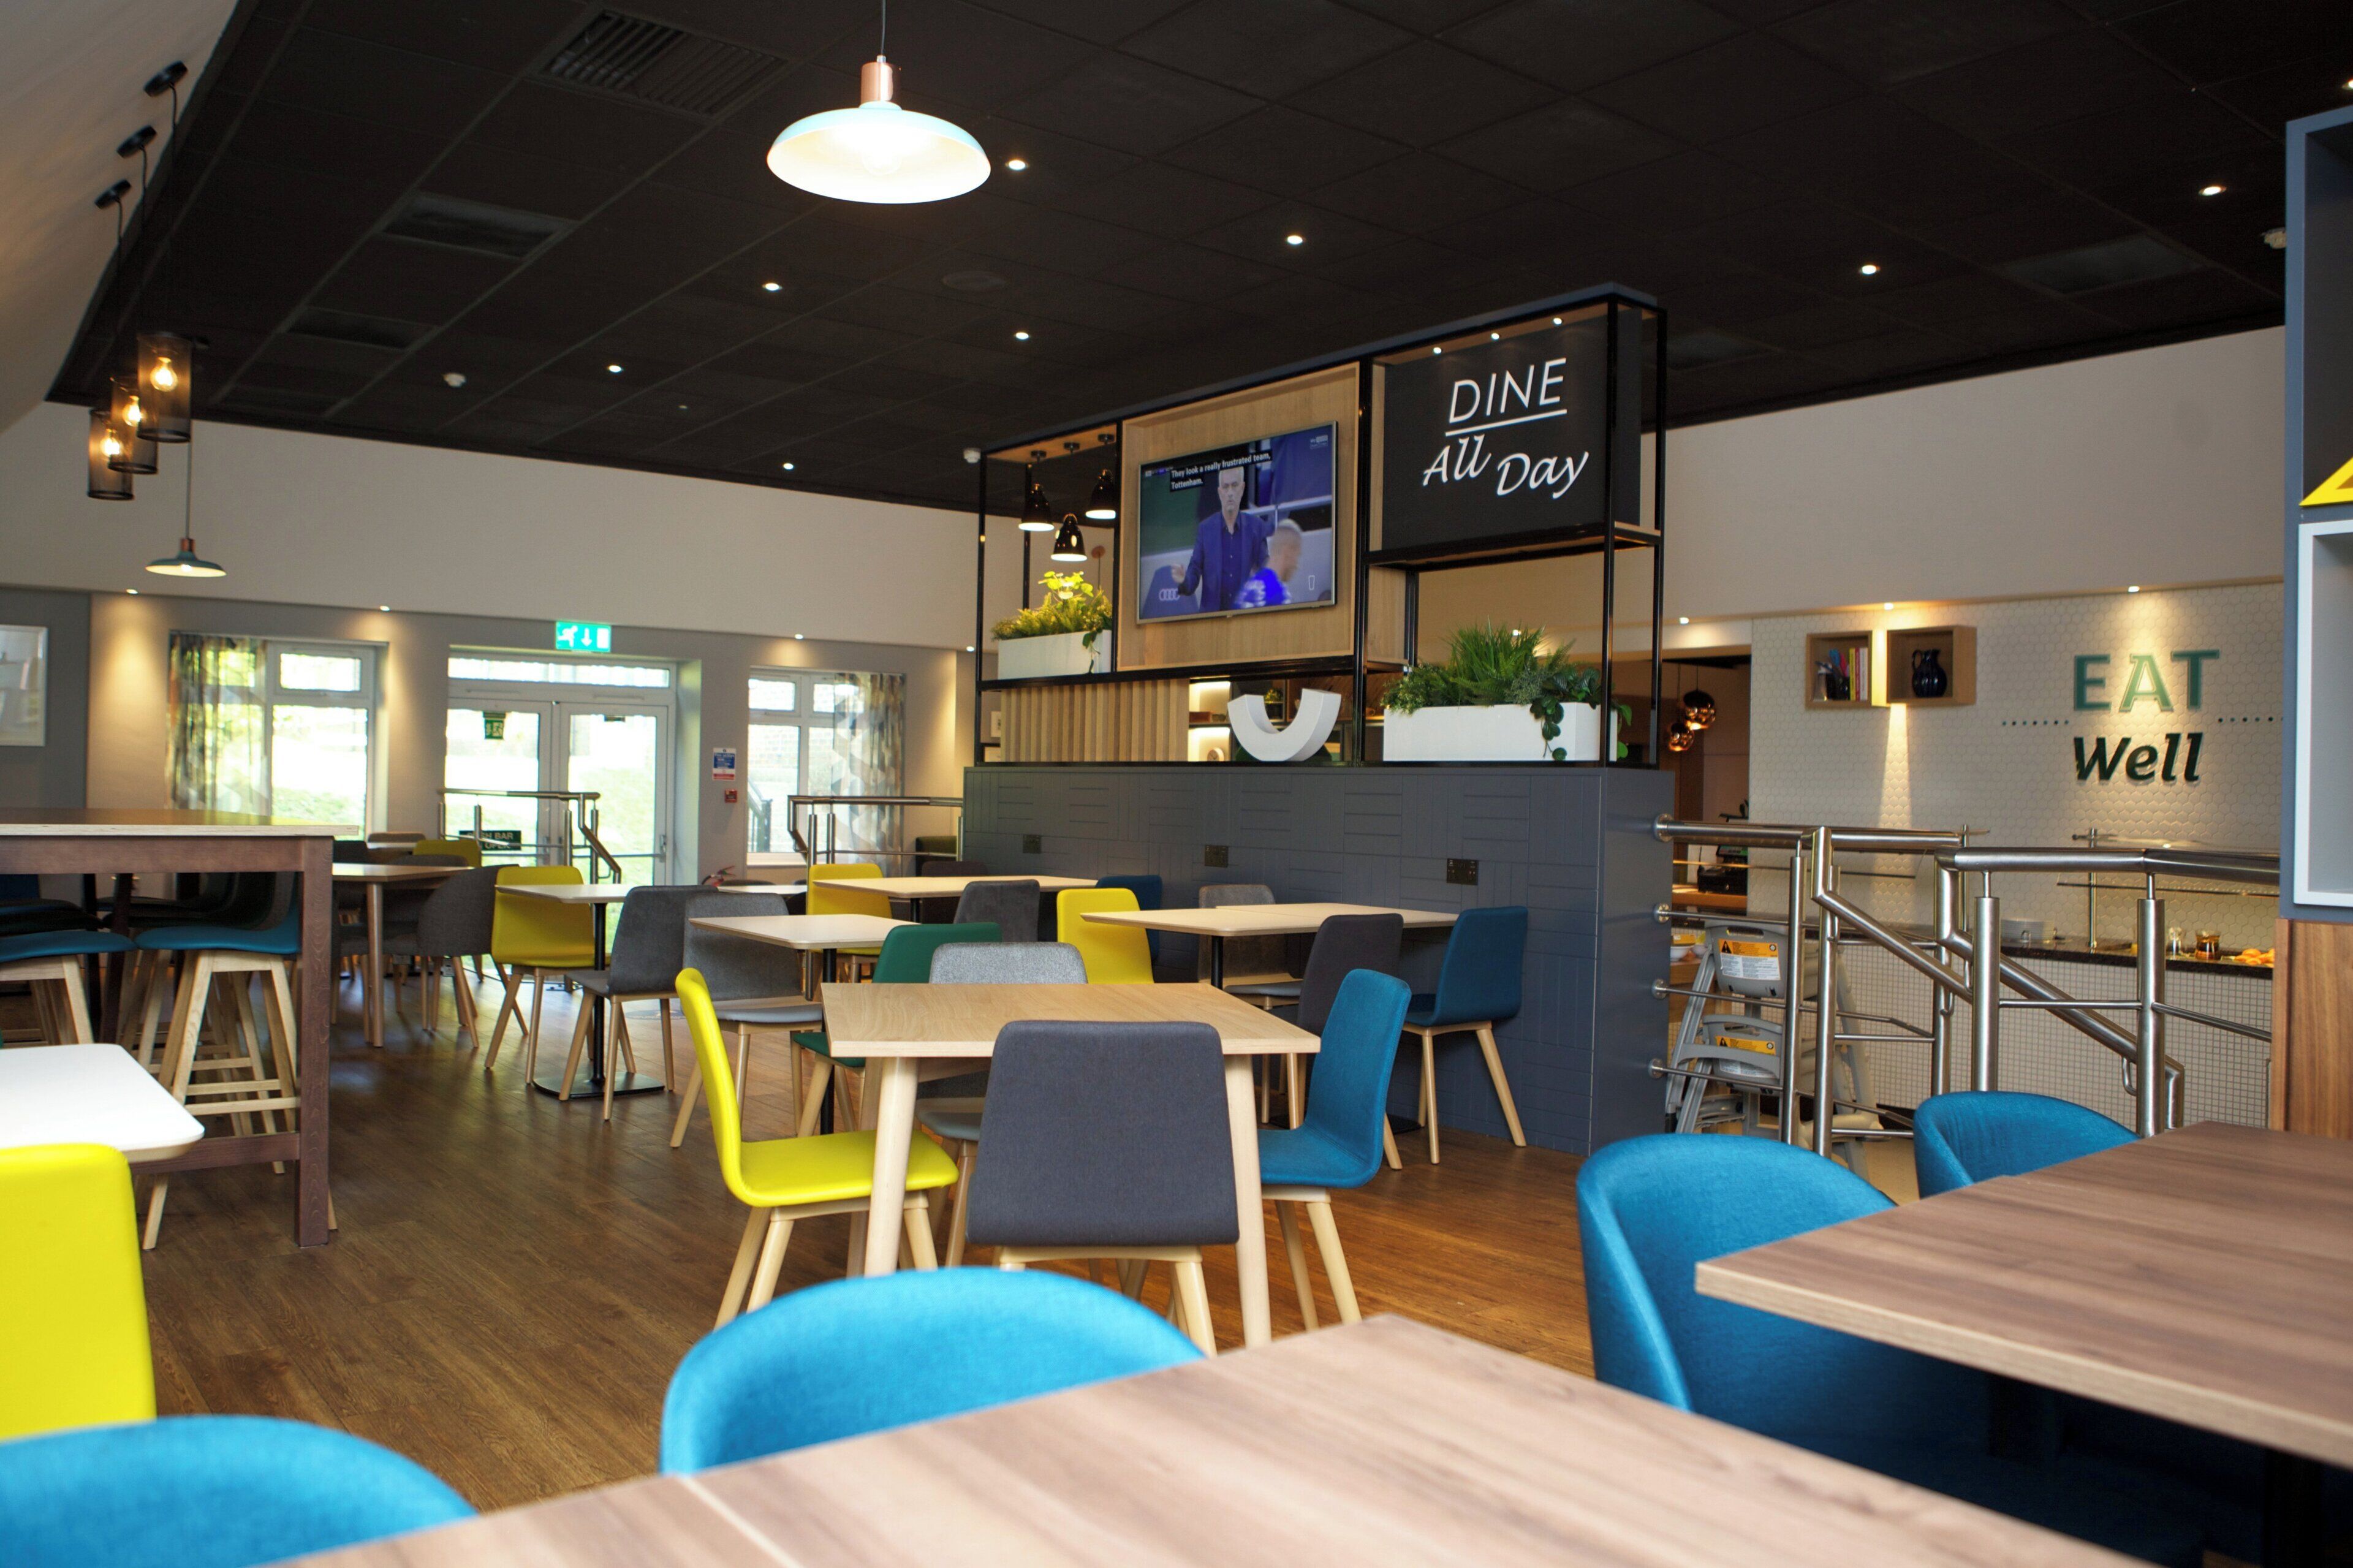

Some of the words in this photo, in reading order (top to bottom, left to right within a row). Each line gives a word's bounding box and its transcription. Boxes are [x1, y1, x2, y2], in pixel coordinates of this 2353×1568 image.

[1449, 357, 1566, 423] DINE
[1171, 478, 1203, 490] Tottenham.
[1186, 466, 1199, 475] look
[1205, 462, 1221, 471] really
[1222, 455, 1251, 468] frustrated
[1253, 452, 1271, 461] team,
[1423, 434, 1491, 486] All
[1497, 451, 1589, 499] Day
[2074, 650, 2220, 713] EAT
[2074, 732, 2203, 782] Well
